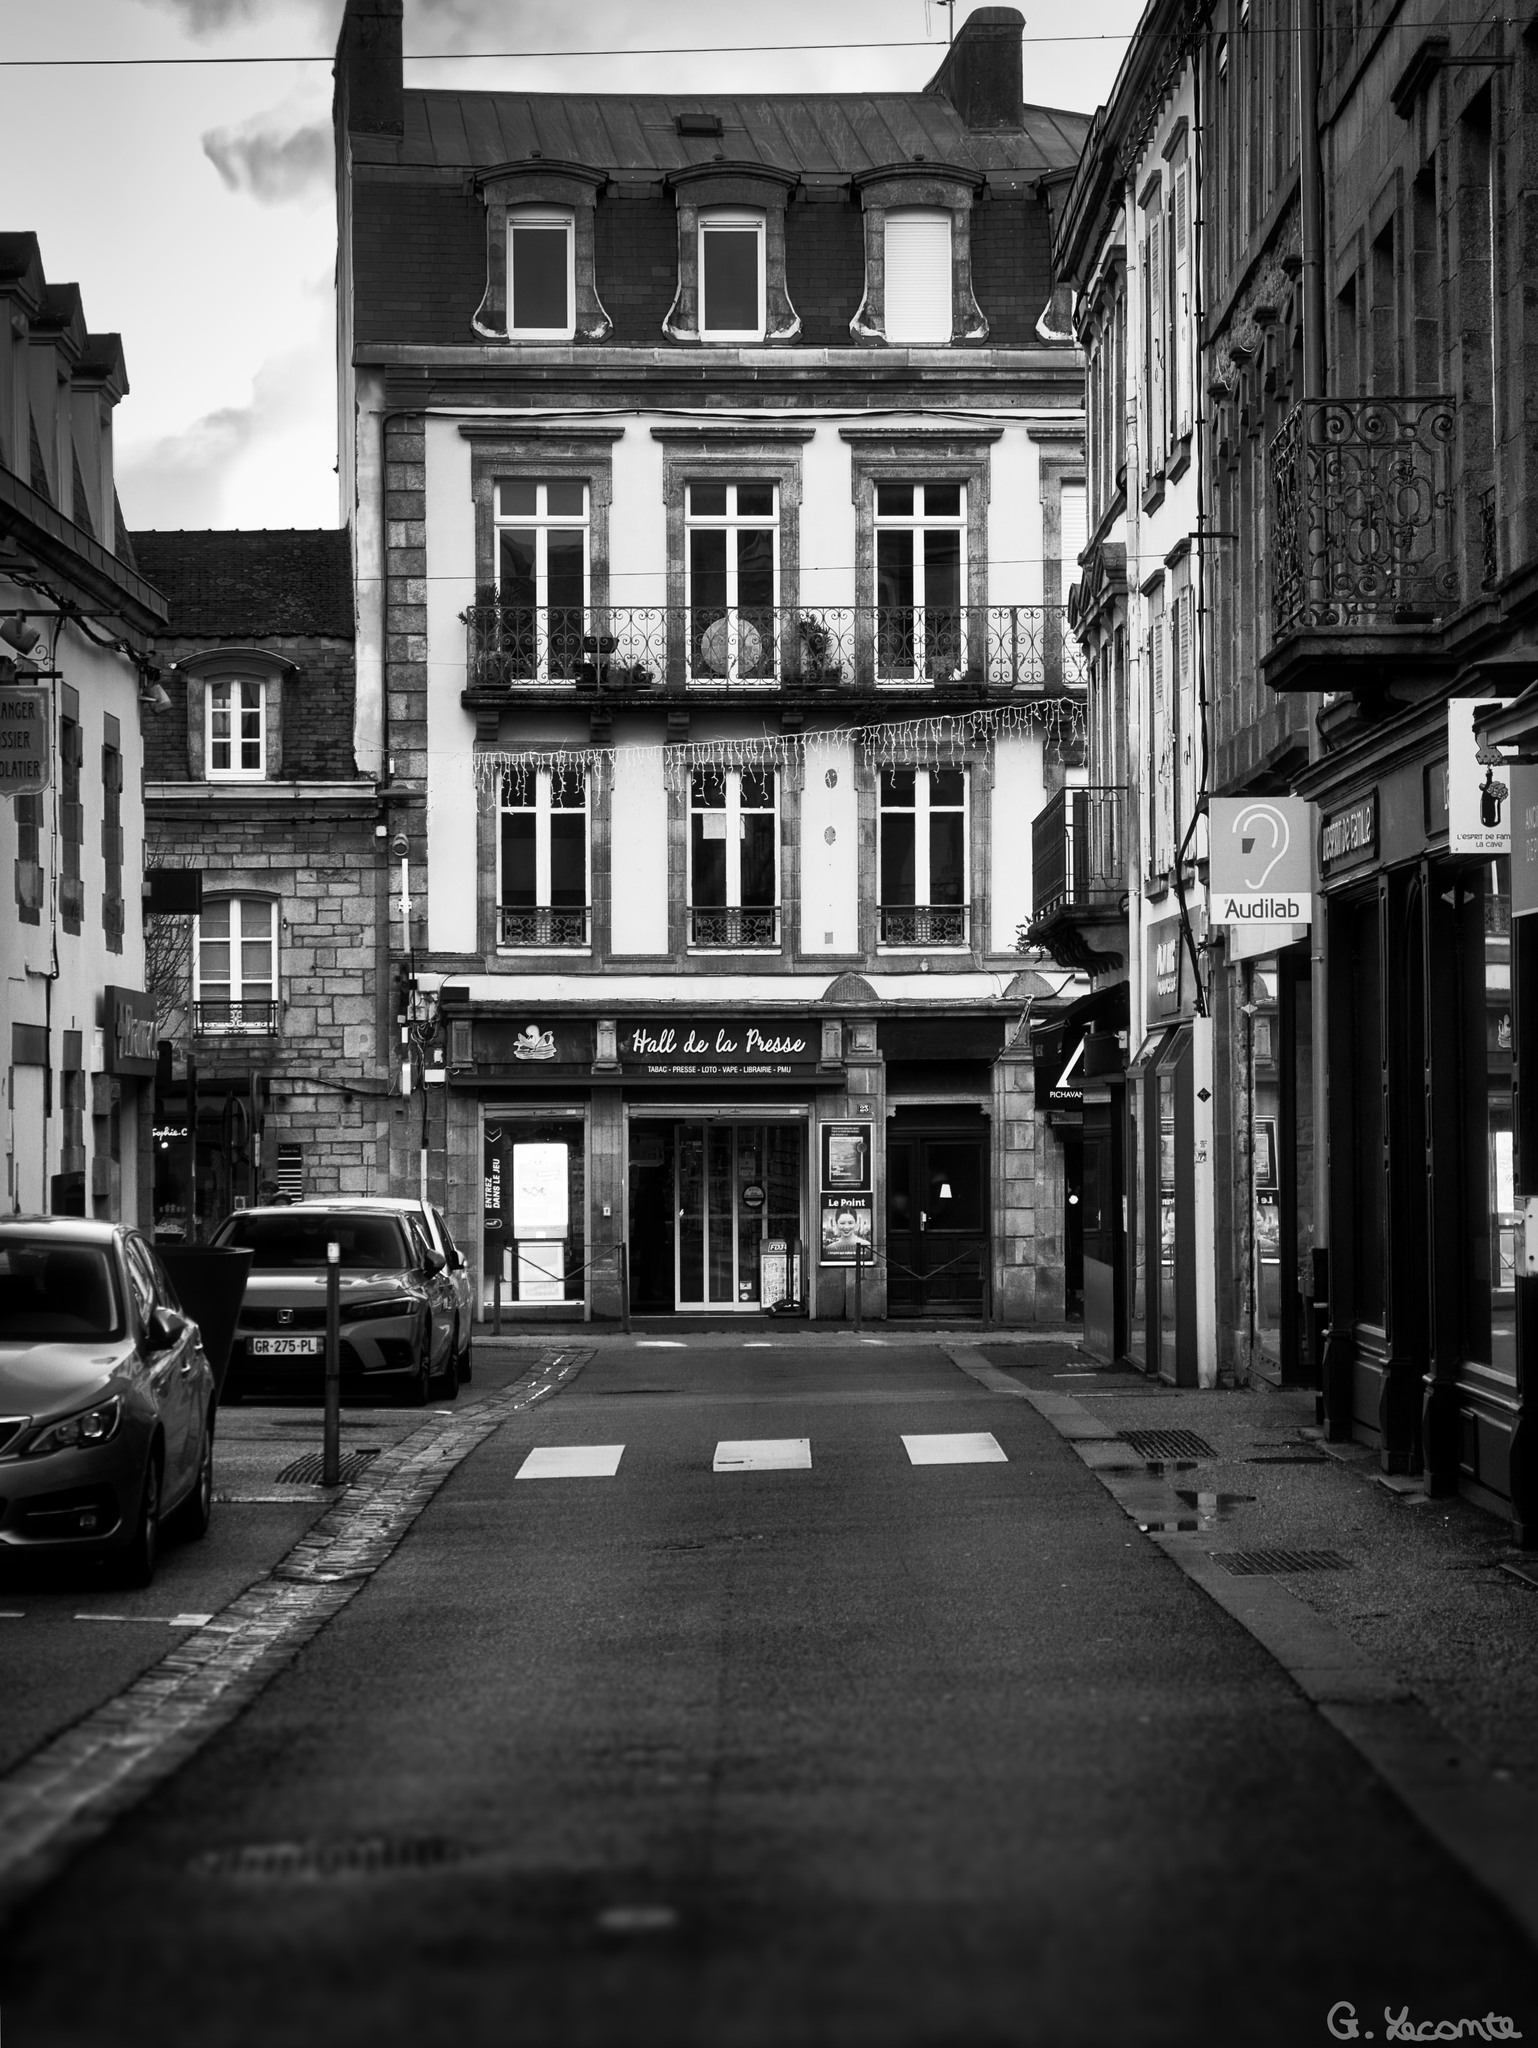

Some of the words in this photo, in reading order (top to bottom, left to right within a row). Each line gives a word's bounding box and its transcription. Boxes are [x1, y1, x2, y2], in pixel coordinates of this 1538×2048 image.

[1224, 898, 1300, 919] Audilab
[632, 1028, 678, 1054] Hall
[683, 1029, 710, 1054] de
[715, 1029, 738, 1054] la
[745, 1028, 806, 1054] Presse
[647, 1065, 668, 1074] TABAC
[672, 1065, 697, 1074] PRESSE
[701, 1065, 718, 1074] LOTO
[721, 1065, 739, 1074] VAPE
[743, 1065, 772, 1074] LIBRAIRIE
[776, 1065, 792, 1074] PMU
[493, 1158, 501, 1174] JEU
[493, 1174, 501, 1185] LE
[484, 1177, 492, 1209] ENTREZ
[493, 1185, 501, 1209] DANS
[828, 1198, 840, 1207] Le
[840, 1197, 866, 1207] Point
[254, 1339, 316, 1354] GR-275-PL
